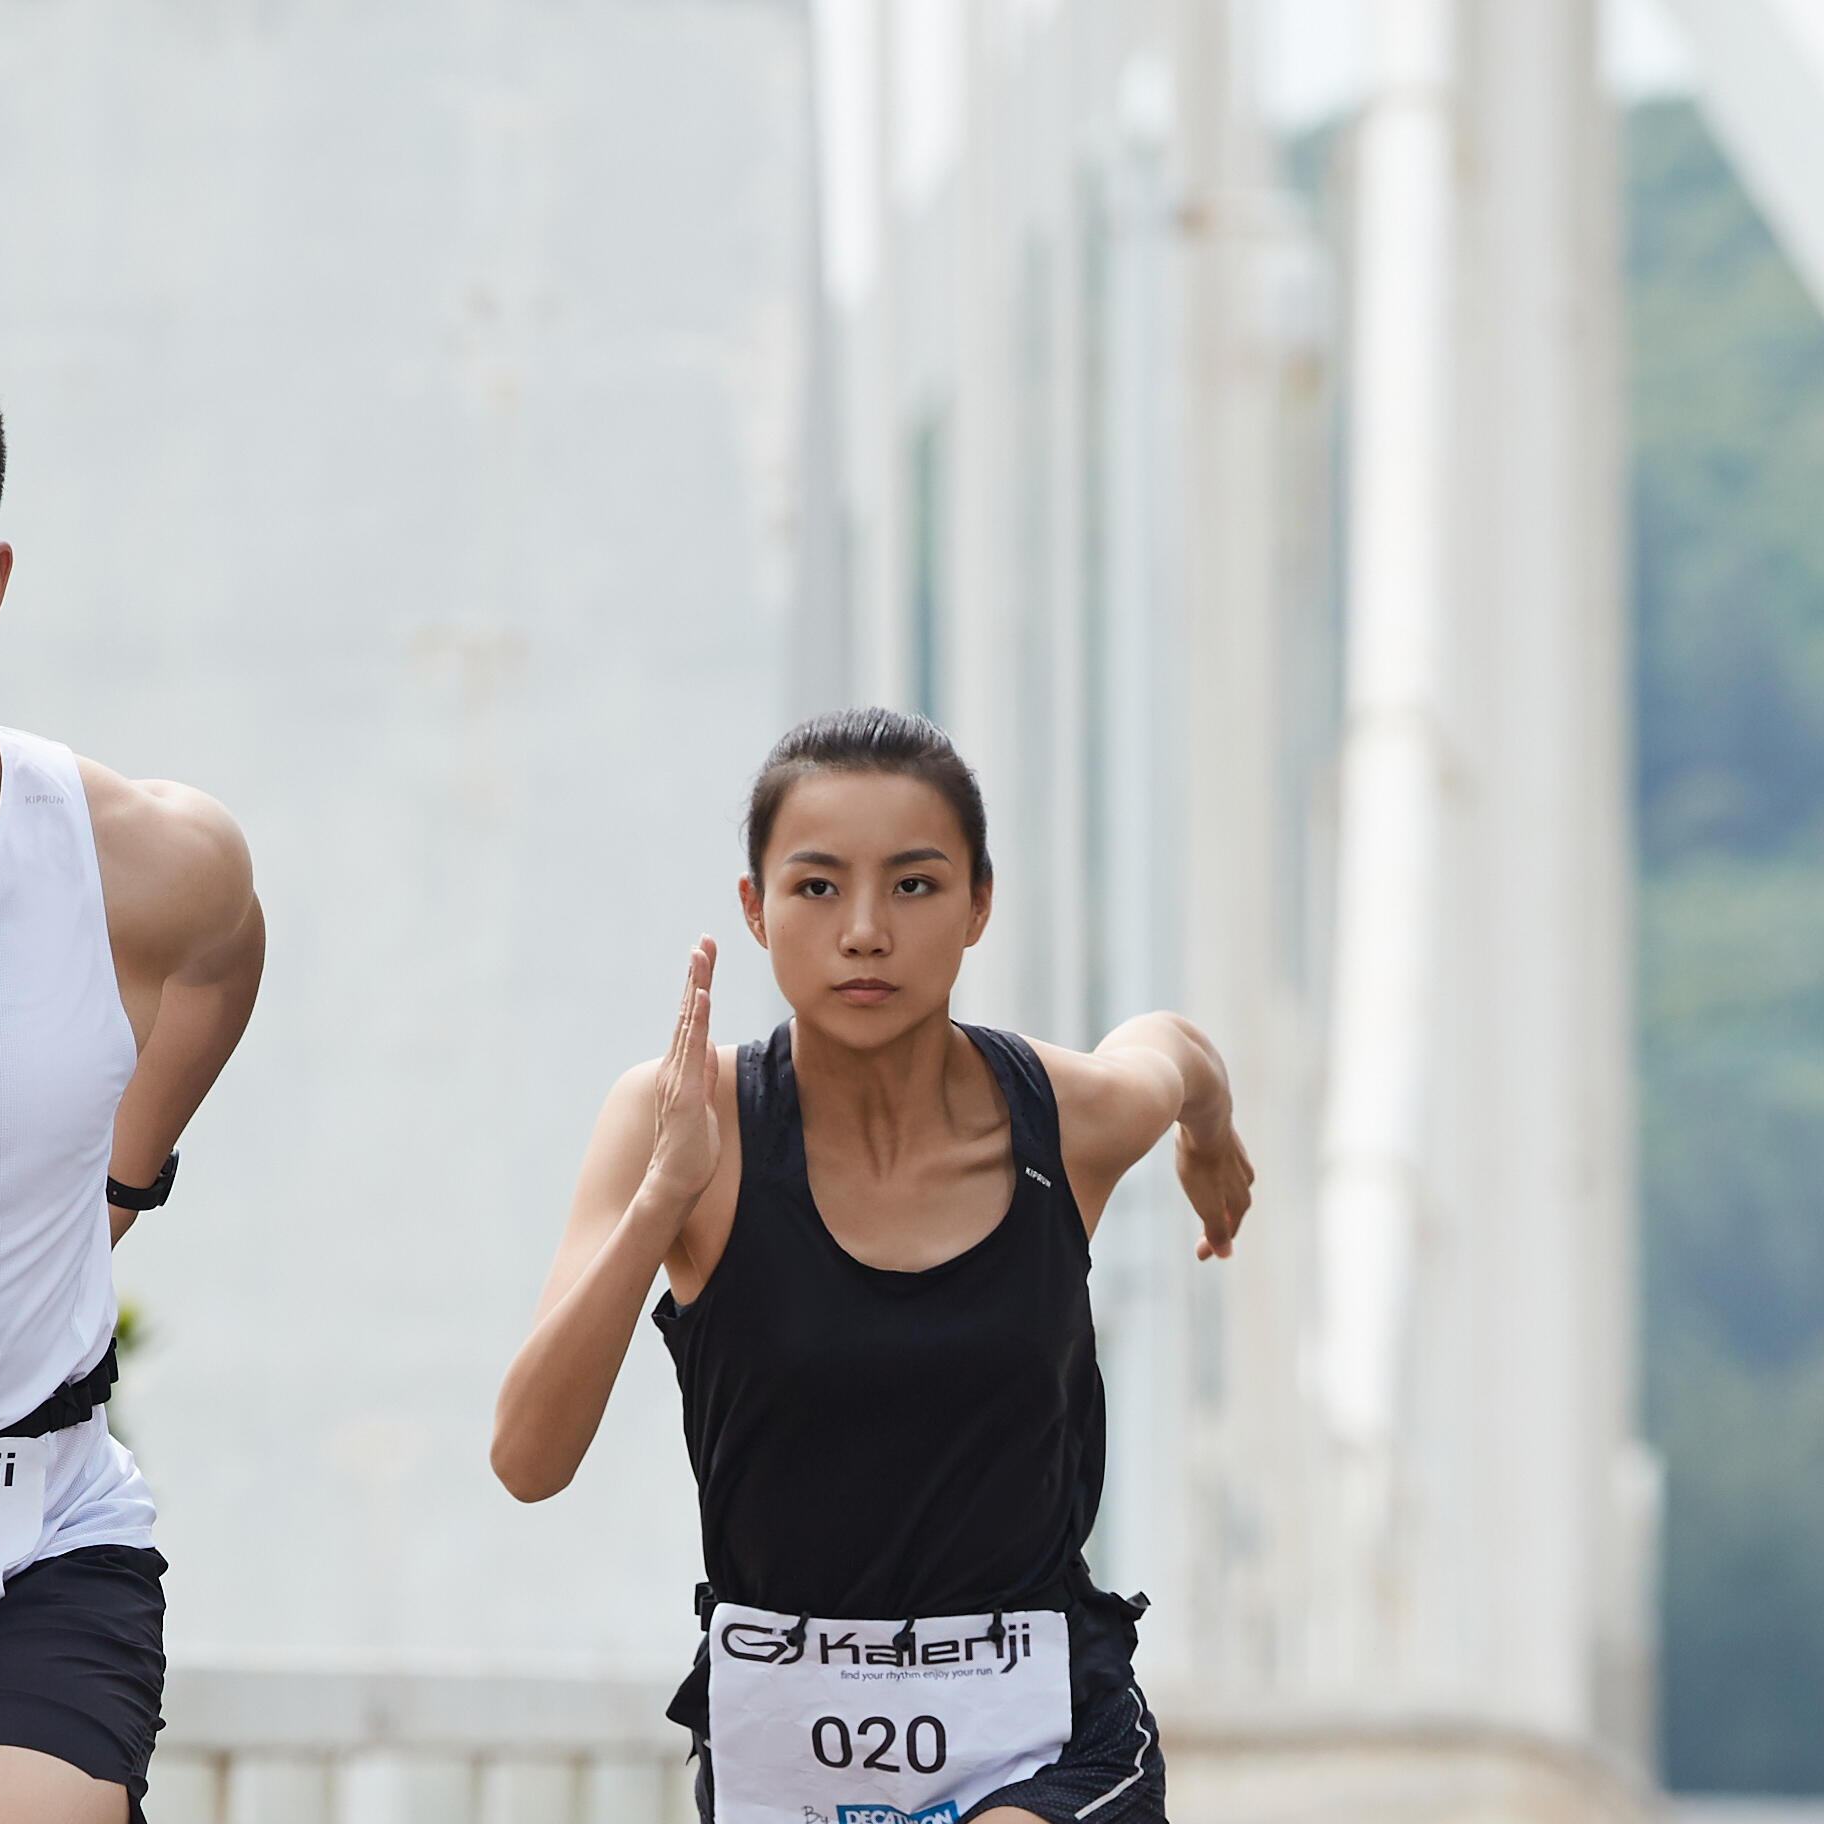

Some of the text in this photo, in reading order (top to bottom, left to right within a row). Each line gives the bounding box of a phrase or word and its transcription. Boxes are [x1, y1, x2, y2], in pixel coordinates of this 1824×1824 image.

[24, 795, 65, 805] KIPRUN
[819, 1622, 1032, 1674] Kalenji
[840, 1667, 993, 1682] find your rhythm enjoy your run
[811, 1714, 948, 1775] 020
